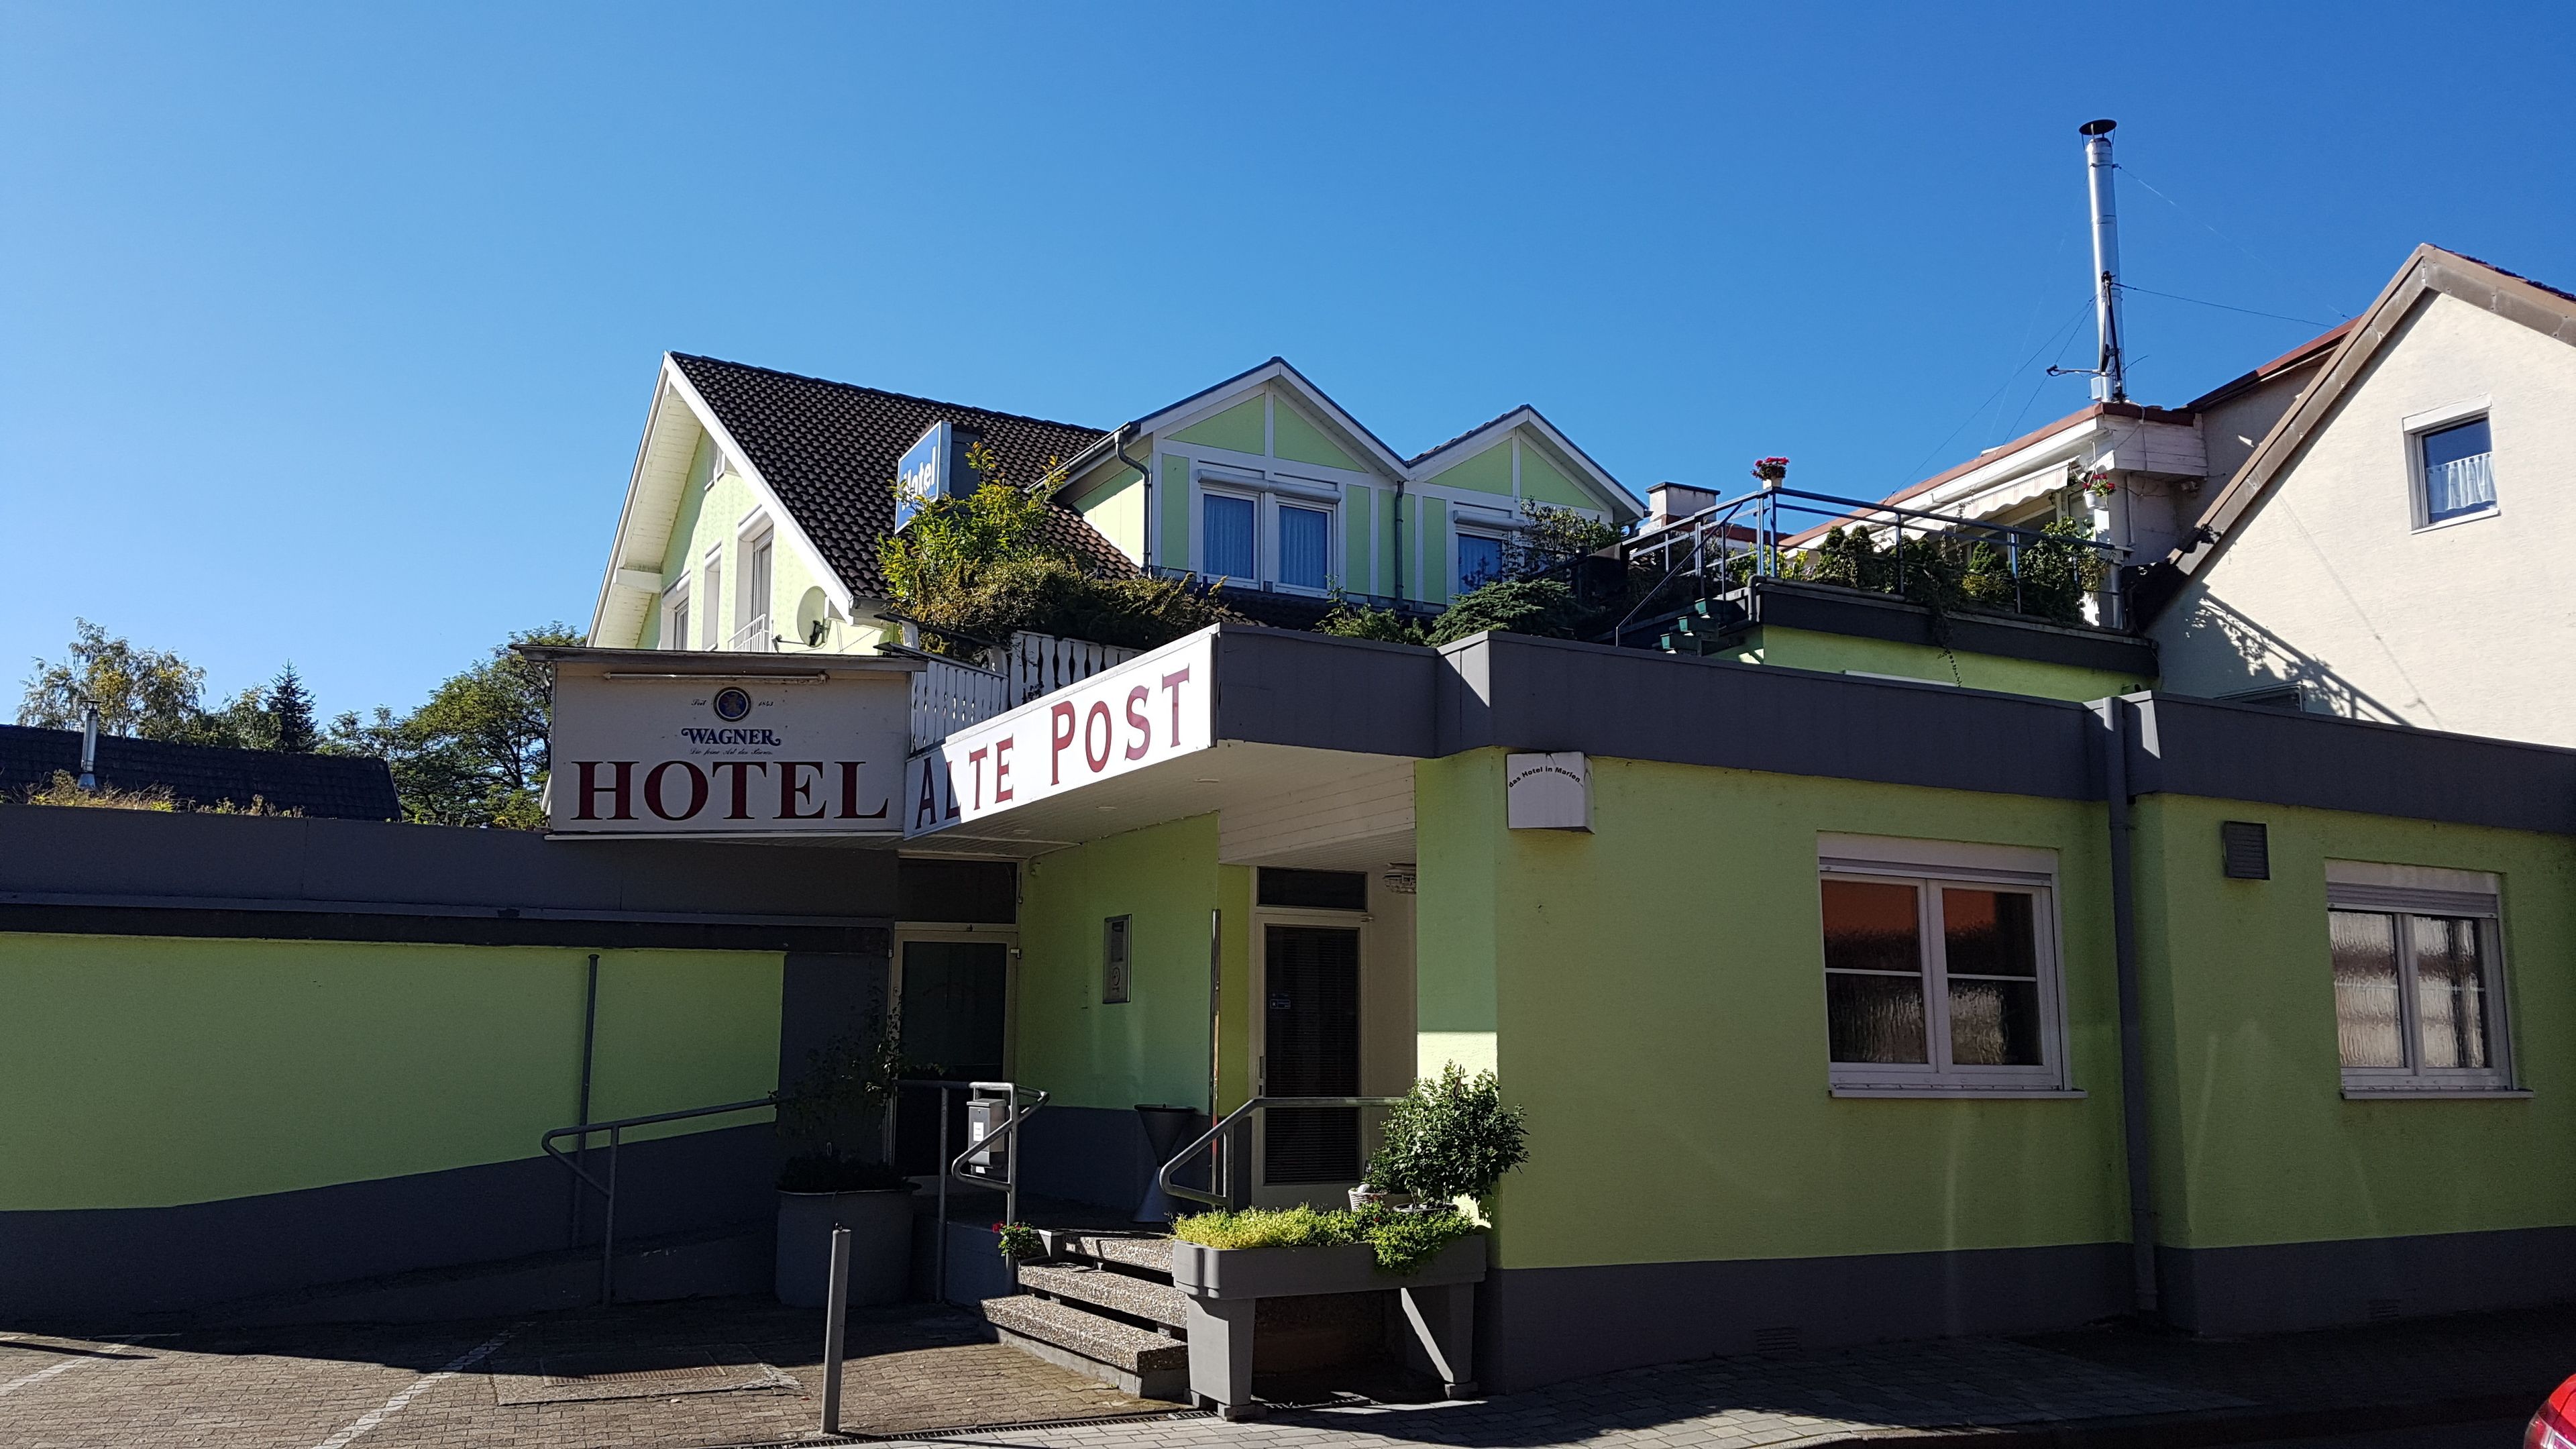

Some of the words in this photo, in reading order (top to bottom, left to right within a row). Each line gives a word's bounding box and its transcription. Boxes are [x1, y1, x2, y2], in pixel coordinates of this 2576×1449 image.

[902, 445, 936, 511] Hotel
[681, 728, 782, 747] WAGNER
[914, 733, 1014, 830] ALTE
[1051, 662, 1190, 786] POST
[570, 760, 889, 821] HOTEL
[1521, 766, 1543, 777] Hotel
